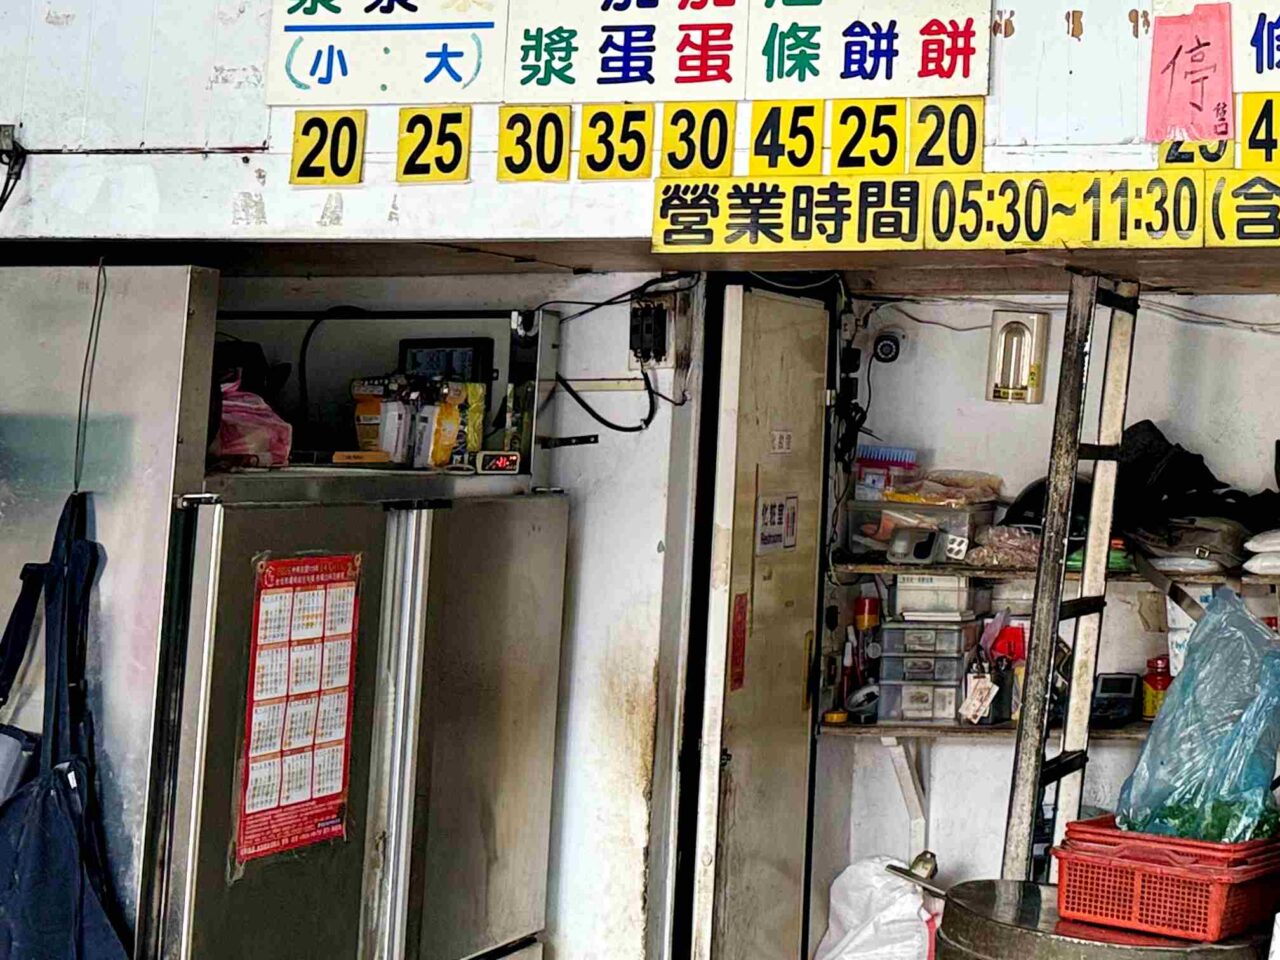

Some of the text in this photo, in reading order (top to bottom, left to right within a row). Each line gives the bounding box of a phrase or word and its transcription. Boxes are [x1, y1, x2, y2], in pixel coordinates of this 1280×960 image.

[296, 116, 358, 178] 20
[403, 112, 463, 175] 25
[504, 112, 563, 175] 30
[586, 110, 646, 172] 35
[667, 108, 728, 171] 30
[754, 104, 815, 168] 45
[838, 103, 899, 167] 25
[915, 102, 977, 166] 20
